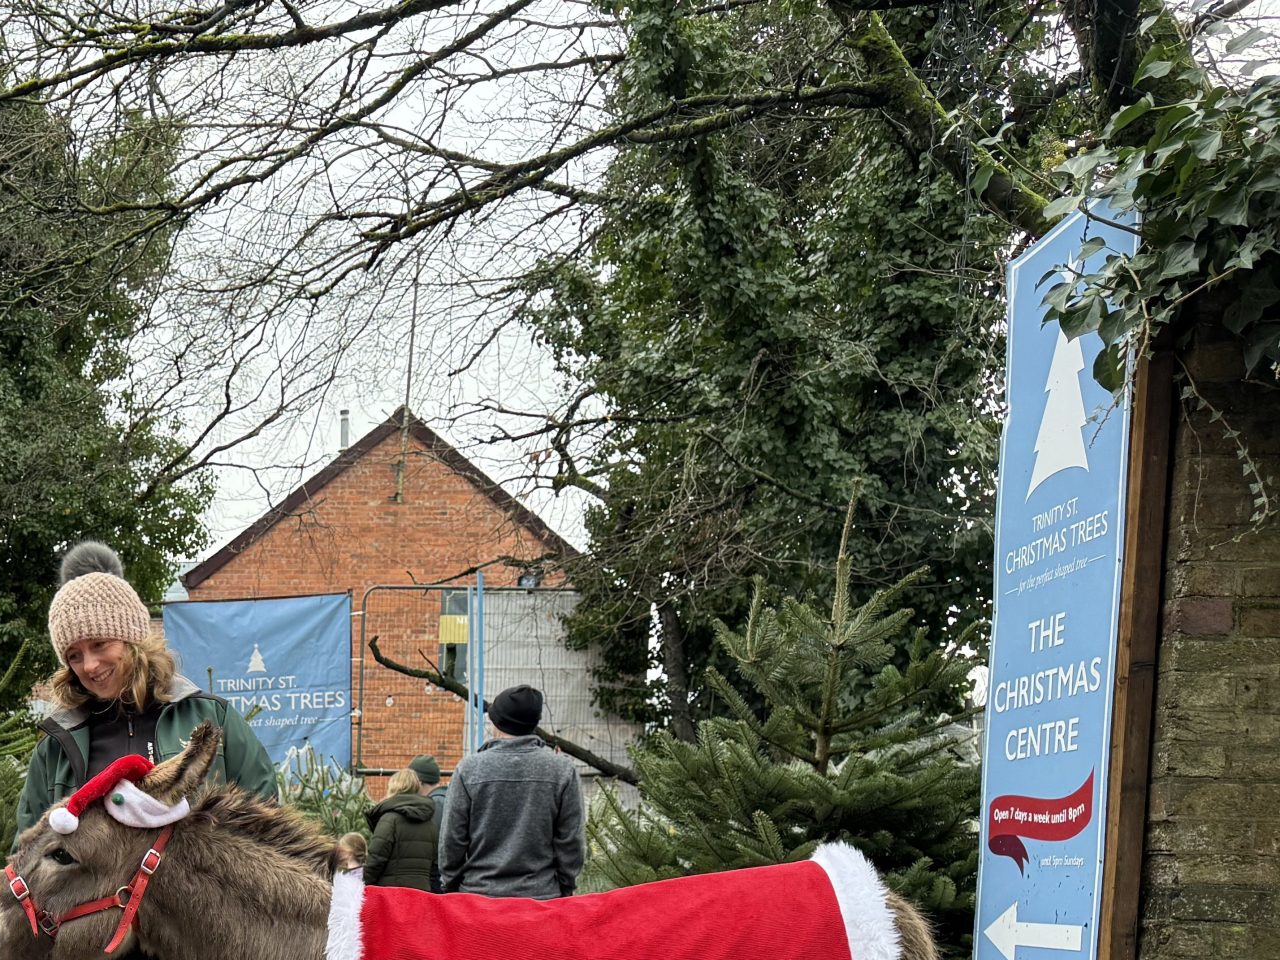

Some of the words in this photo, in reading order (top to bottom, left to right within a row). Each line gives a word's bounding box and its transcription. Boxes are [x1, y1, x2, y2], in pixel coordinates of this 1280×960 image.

[1032, 503, 1065, 533] TRINITY
[1066, 497, 1078, 518] ST.
[1005, 528, 1067, 574] CHRISTMAS
[1070, 511, 1108, 547] TREES
[1028, 611, 1066, 653] THE
[216, 677, 276, 692] TRINITY
[278, 675, 297, 689] ST.
[286, 691, 346, 710] TREES
[994, 656, 1102, 713] CHRISTMAS
[264, 714, 299, 729] shaped
[300, 715, 318, 725] tree
[1005, 717, 1079, 761] CENTRE
[993, 808, 1009, 824] Open
[1010, 807, 1014, 820] 7
[1014, 808, 1027, 824] days
[1033, 811, 1050, 824] week
[1051, 809, 1066, 824] until
[1068, 803, 1085, 822] 8pm
